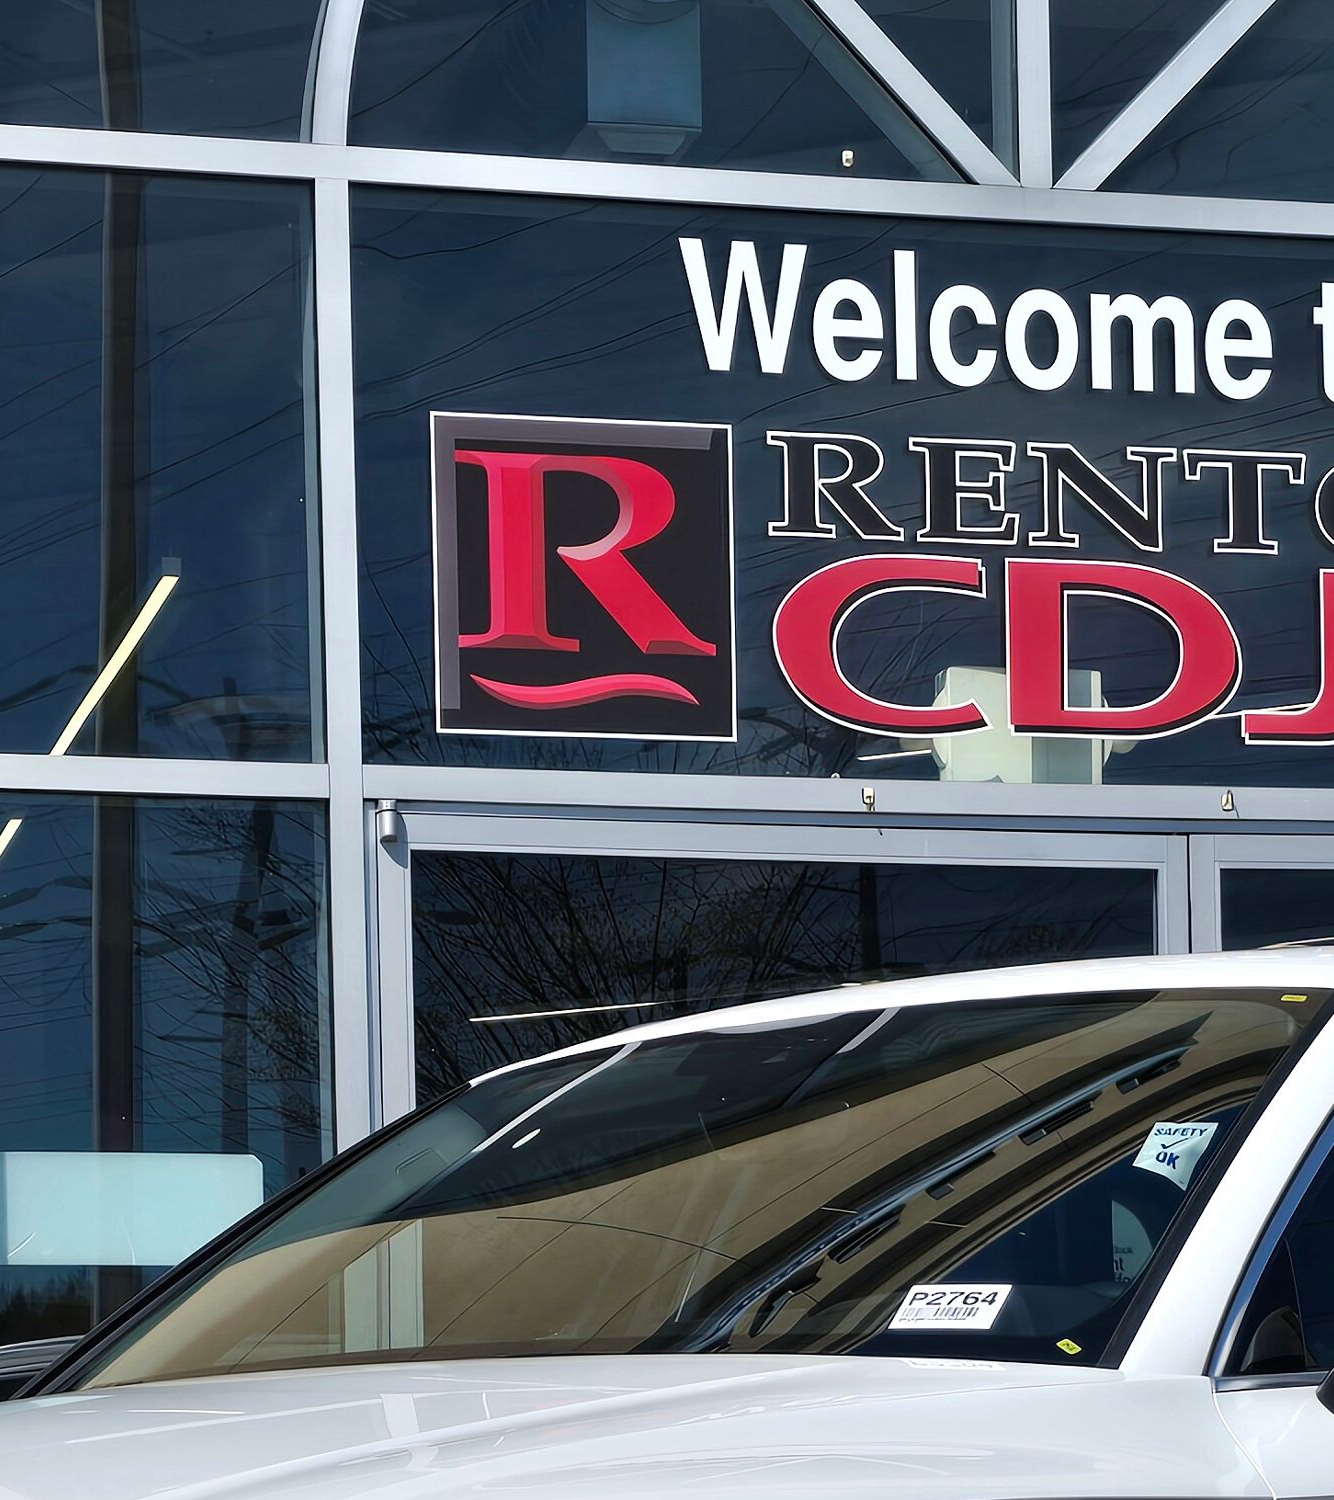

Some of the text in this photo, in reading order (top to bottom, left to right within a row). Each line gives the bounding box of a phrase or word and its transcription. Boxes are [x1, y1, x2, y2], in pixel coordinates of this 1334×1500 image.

[678, 237, 1272, 402] Welcome
[454, 449, 718, 656] R
[1153, 1127, 1209, 1137] SAFETY
[1155, 1151, 1180, 1170] OK
[908, 1291, 999, 1306] P2764
